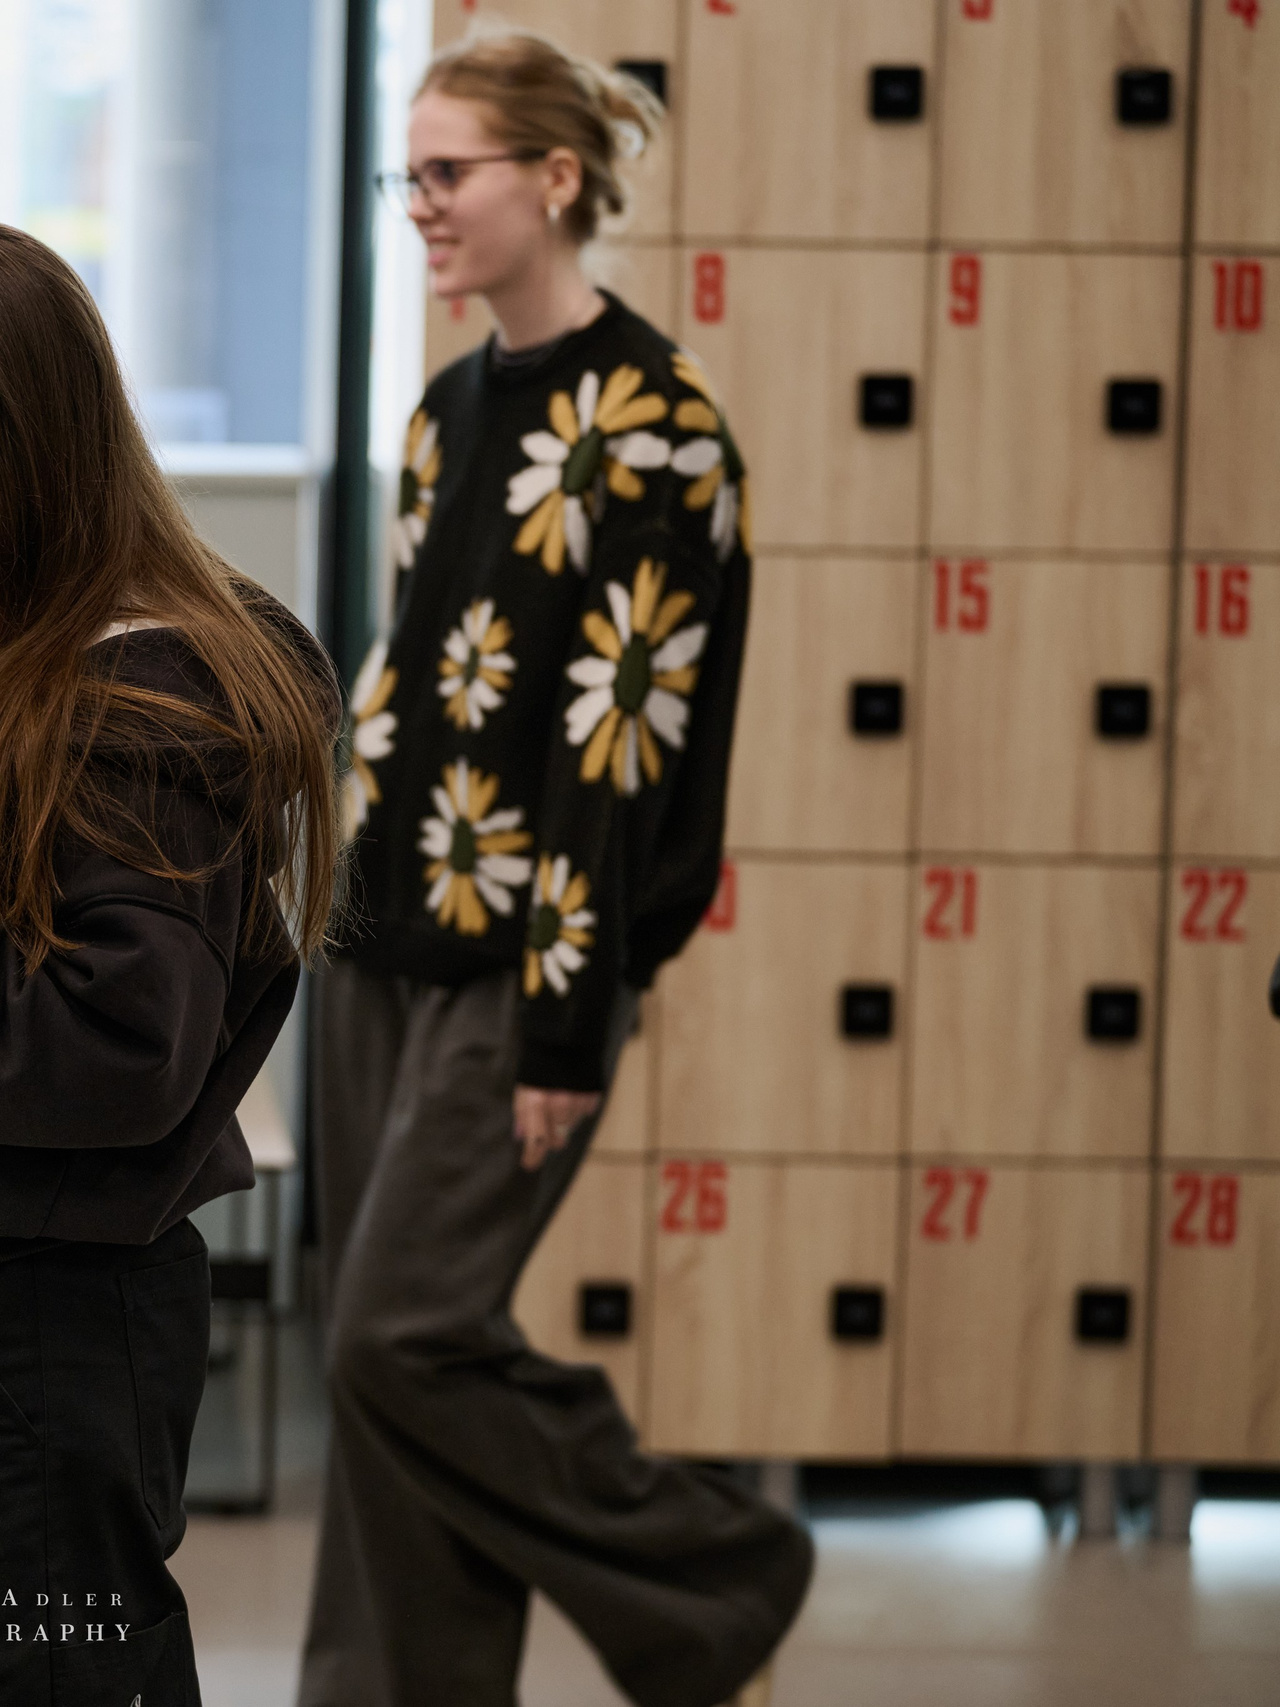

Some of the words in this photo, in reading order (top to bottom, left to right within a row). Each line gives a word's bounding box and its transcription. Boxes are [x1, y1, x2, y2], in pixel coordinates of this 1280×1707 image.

[691, 254, 725, 323] 8
[948, 255, 981, 326] 9
[1212, 260, 1265, 332] 10
[933, 560, 990, 633] 15
[1192, 565, 1252, 636] 16
[923, 868, 977, 940] 21
[1180, 870, 1250, 941] 22
[660, 1161, 727, 1232] 26
[921, 1168, 989, 1240] 27
[1170, 1176, 1240, 1245] 28
